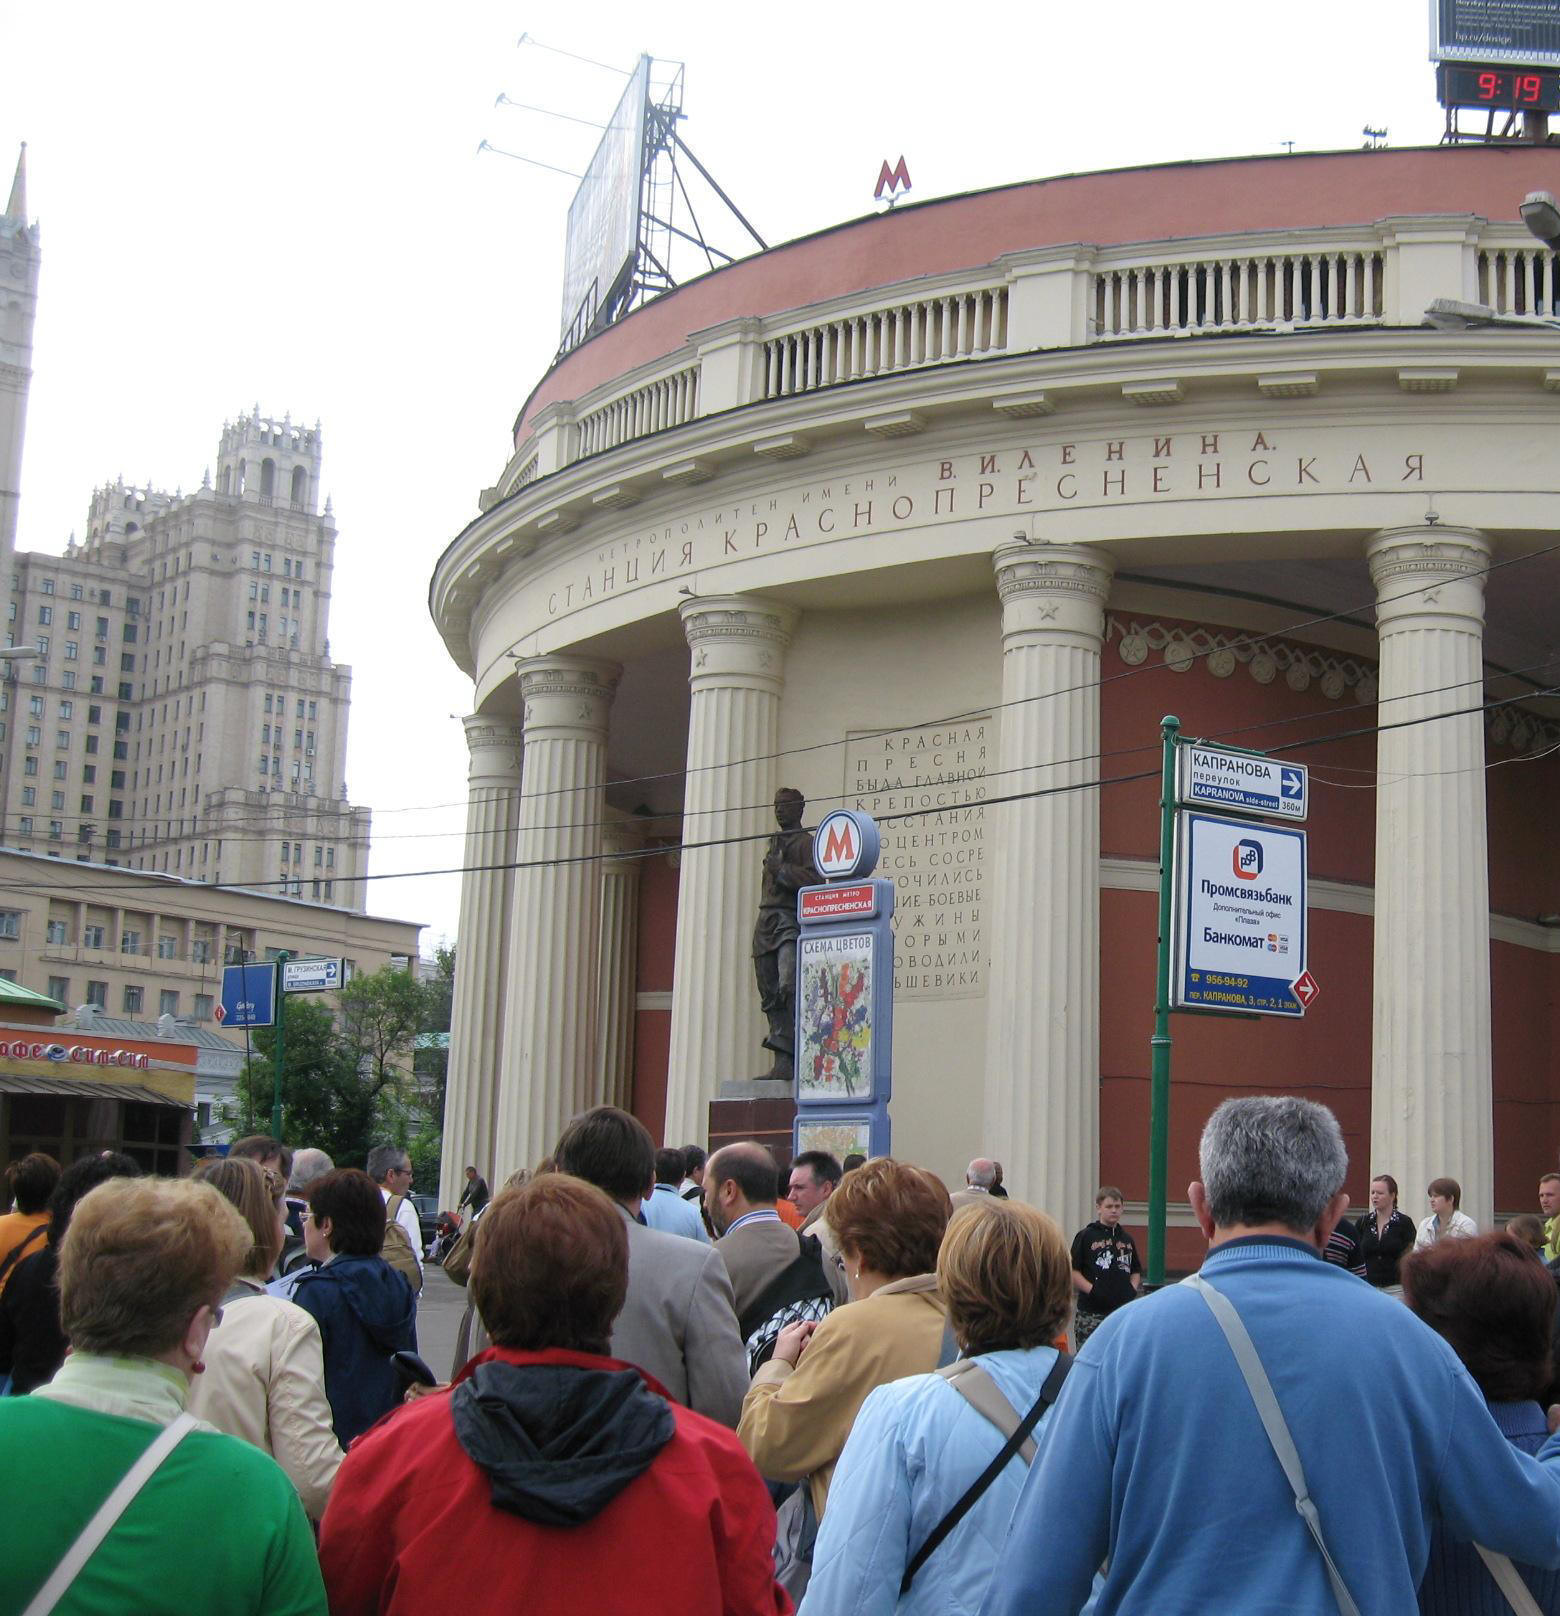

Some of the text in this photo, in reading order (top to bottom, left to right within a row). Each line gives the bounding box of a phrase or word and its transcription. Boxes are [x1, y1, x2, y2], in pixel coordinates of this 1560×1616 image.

[1478, 73, 1541, 101] 9:19
[599, 498, 778, 562] МЕТРОПОЛИТЕН
[802, 475, 898, 503] ИМЕНИ
[548, 453, 1424, 615] СТАНЦИЯ КРАСНОПРЕСНЕНСКАЯ
[885, 726, 984, 751] КРАСНАЯ
[857, 746, 986, 771] ПРЕСНЯ
[1193, 753, 1272, 779] КАПРАНОВА
[1193, 771, 1240, 787] переулок
[856, 787, 986, 811] КРЕПОСТЬЮ
[1194, 785, 1279, 808] KAPRANOVA side-street
[1281, 801, 1301, 812] 360м
[881, 856, 916, 868] ЕСЬ
[815, 890, 861, 901] СТАНЦИЯ МЕТРО
[928, 889, 982, 906] БОЕВЫЕ
[1201, 879, 1293, 906] Промсвязьбанк
[803, 900, 872, 915] КРАСНОПРЕСНЕНСКАЯ
[1213, 902, 1281, 920] Дополнительный офис
[803, 936, 871, 955] СХЕМА ЦВЕТОВ
[904, 929, 980, 948] ОРЫМИ
[1203, 927, 1265, 949] Банкомат
[1206, 974, 1248, 988] 956-94-92
